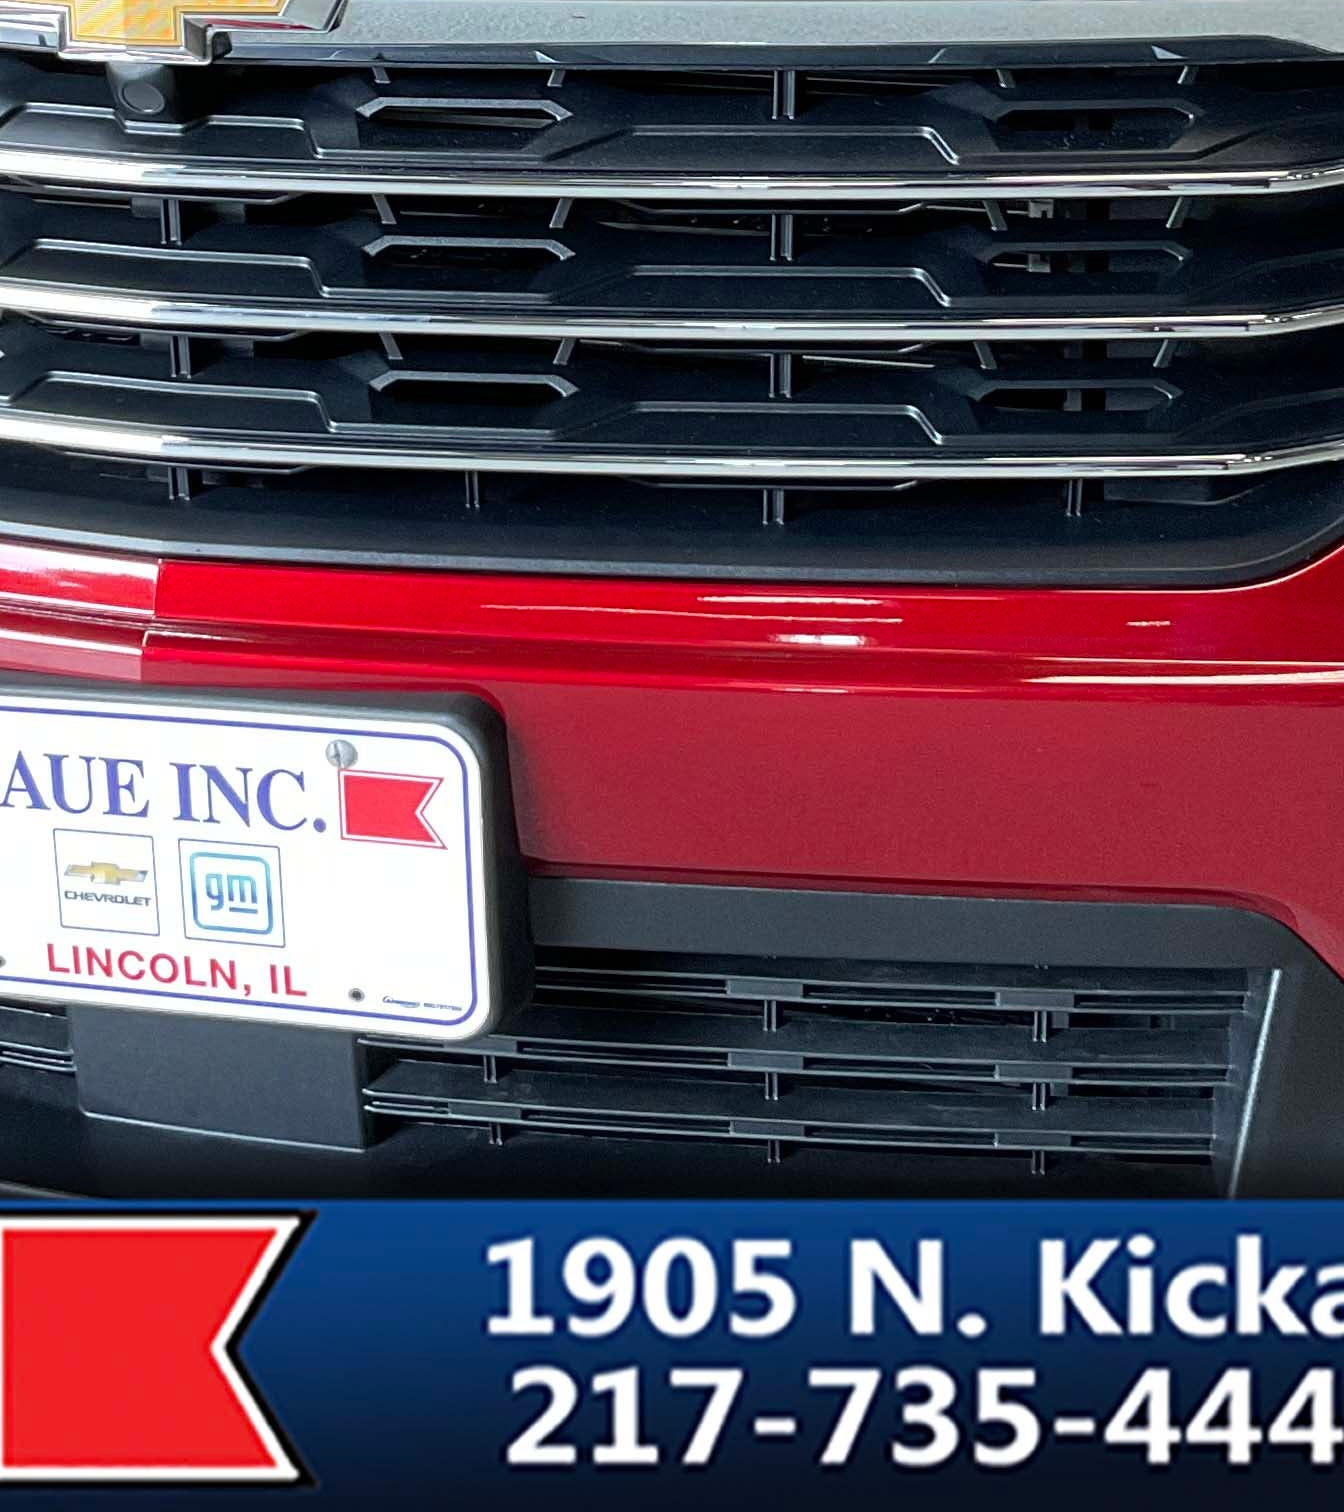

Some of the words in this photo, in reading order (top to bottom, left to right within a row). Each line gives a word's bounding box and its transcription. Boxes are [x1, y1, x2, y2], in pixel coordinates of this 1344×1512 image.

[170, 762, 328, 833] INC.
[63, 890, 152, 906] CHEVROLET
[205, 873, 258, 915] gm
[47, 943, 252, 995] LINCOLN,
[269, 965, 308, 998] IL
